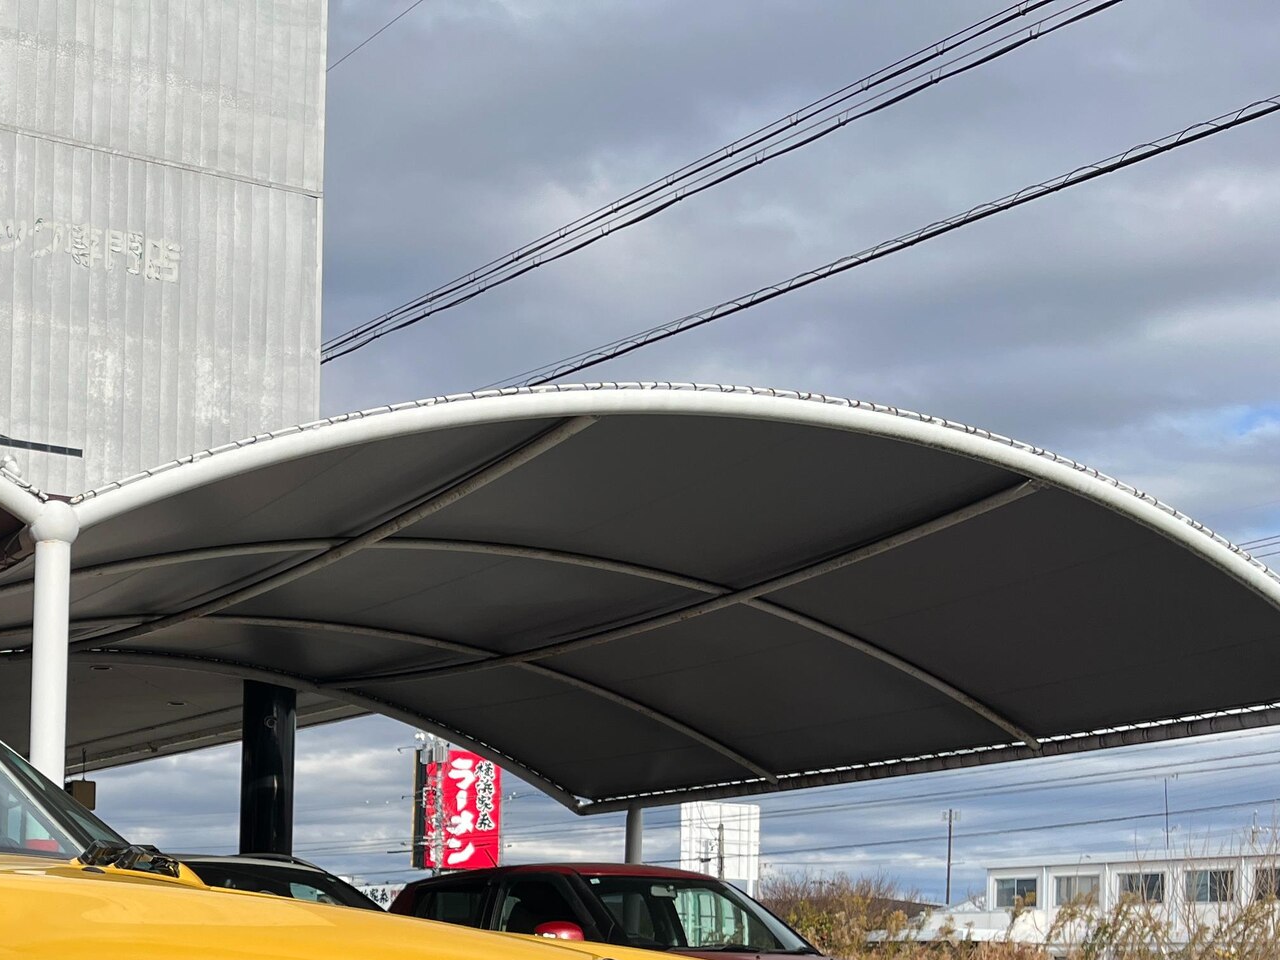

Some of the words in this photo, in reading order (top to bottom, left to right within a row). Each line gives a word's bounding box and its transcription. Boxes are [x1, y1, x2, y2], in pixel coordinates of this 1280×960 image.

[447, 757, 476, 865] ラーメン
[474, 761, 495, 831] 横浜家系
